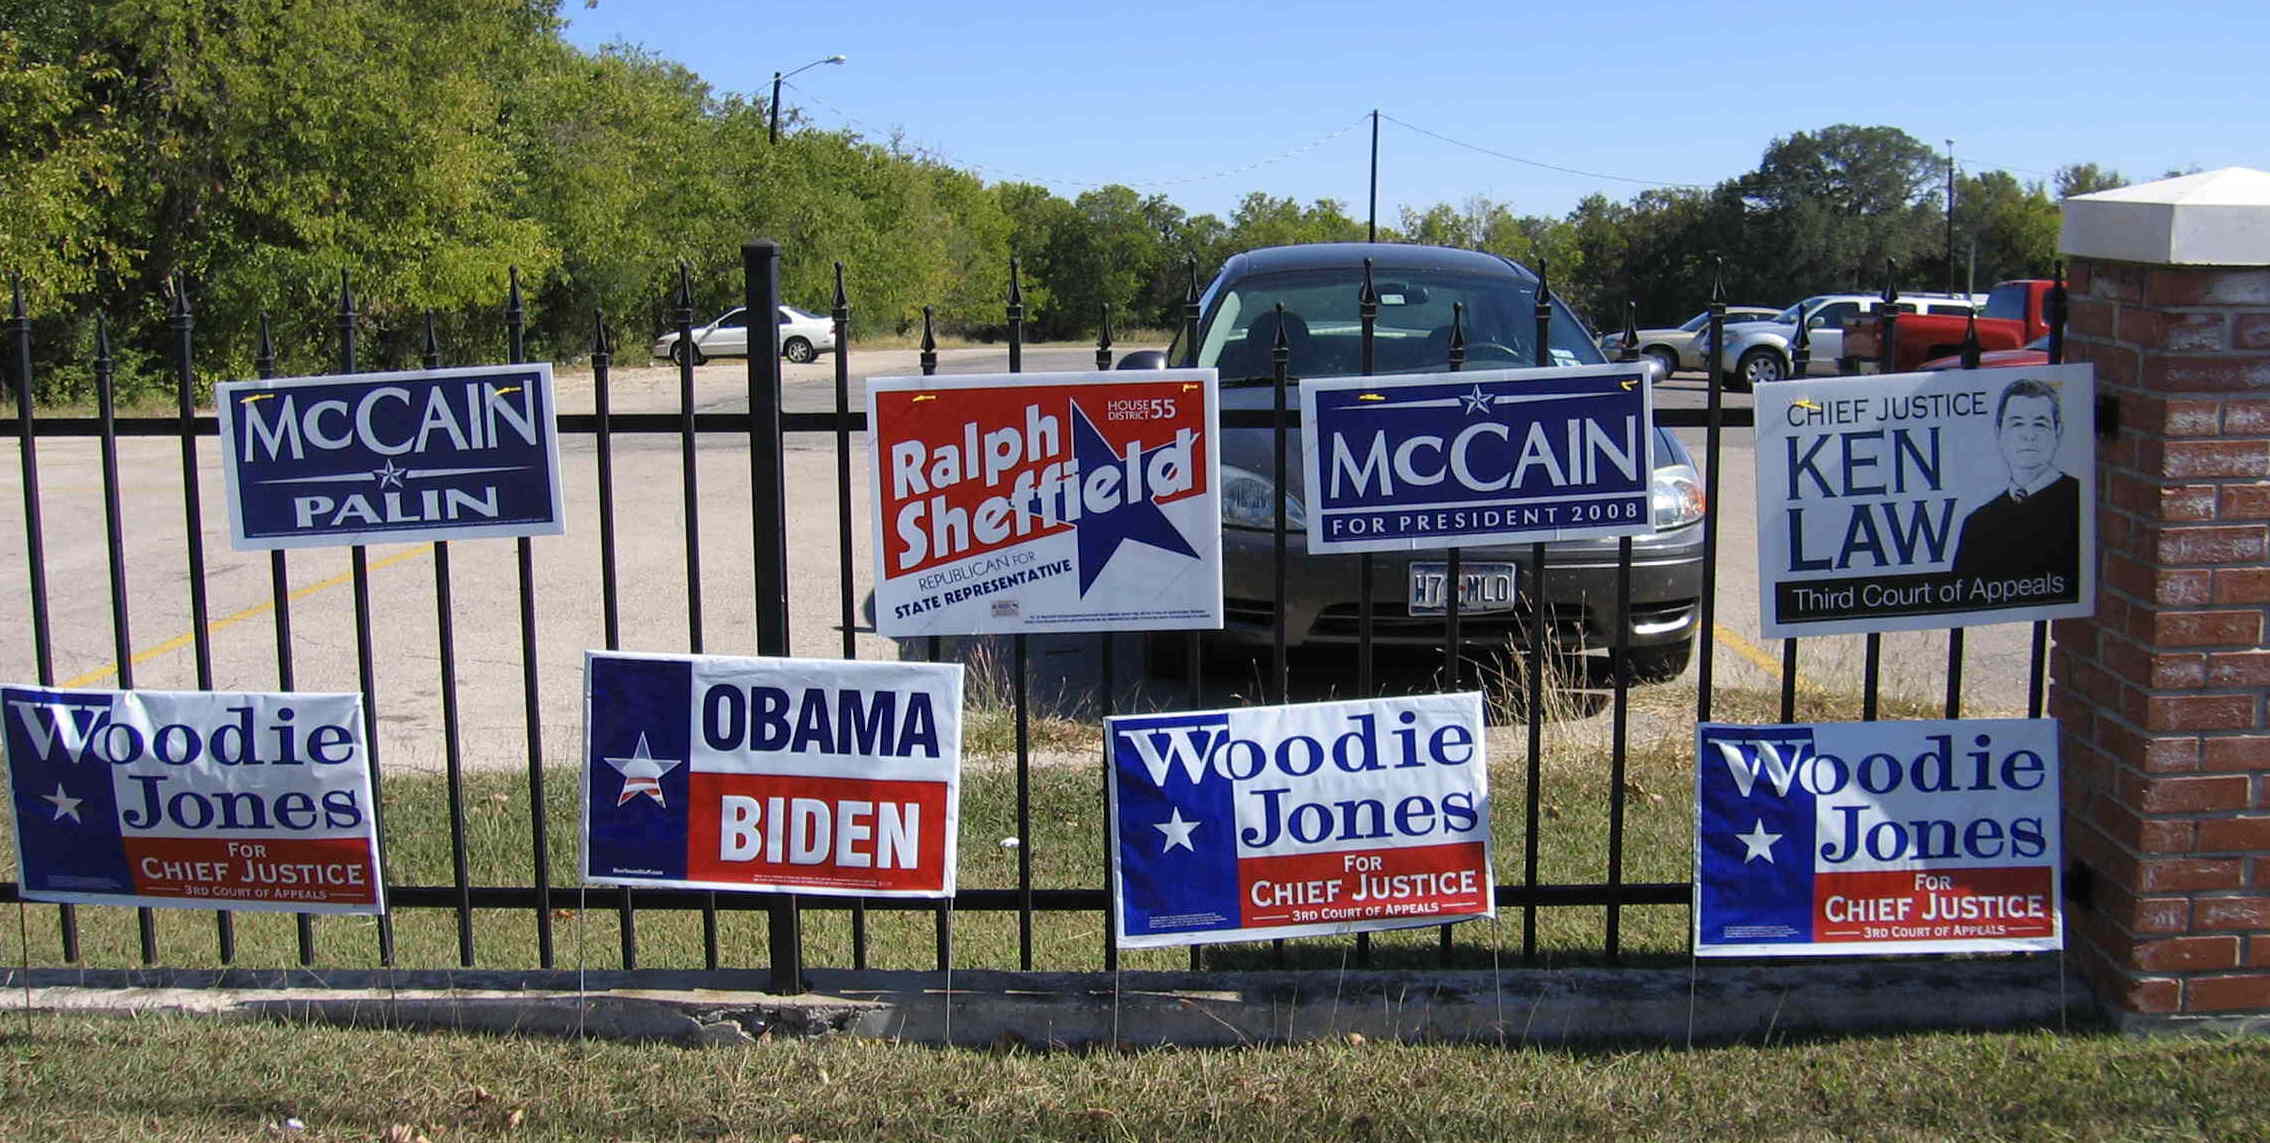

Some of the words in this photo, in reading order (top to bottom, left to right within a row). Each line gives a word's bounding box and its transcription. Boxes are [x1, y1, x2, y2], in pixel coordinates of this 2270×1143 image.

[1107, 399, 1149, 411] HOUSE
[1107, 411, 1149, 421] DISTRICT
[1150, 399, 1176, 419] 55
[1786, 398, 1869, 427] CHIEF
[1876, 392, 1988, 421] JUSTICE
[891, 404, 1059, 500] Ralph
[1785, 426, 1943, 501] KEN
[294, 486, 499, 528] PALIN
[896, 427, 1200, 570] Sheffield
[1332, 519, 1386, 536] FOR
[1400, 507, 1558, 532] PRESIDENT
[1571, 502, 1638, 522] 2008
[1786, 497, 1957, 573] LAW
[895, 595, 942, 619] STATE
[944, 559, 1073, 606] REPRESENTATIVE
[918, 554, 1009, 592] REPUBLICAN
[1012, 551, 1036, 565] FOR
[1793, 585, 1855, 611] Third
[1862, 581, 1932, 607] Court
[1937, 577, 1965, 602] of
[1969, 571, 2065, 602] Appeals
[8, 699, 355, 764] Woodie
[702, 683, 940, 758] OBAMA
[1119, 711, 1473, 787] Woodie
[1708, 735, 2046, 798] Woodie
[122, 774, 362, 830] Jones
[1241, 788, 1478, 848] Jones
[228, 842, 267, 858] FOR
[720, 794, 920, 869] BIDEN
[1820, 806, 2047, 864] Jones
[141, 857, 228, 882] CHIEF
[240, 860, 365, 885] JUSTICE
[1344, 855, 1382, 872] FOR
[1914, 874, 1951, 891] FOR
[212, 887, 252, 899] COURT
[256, 888, 270, 899] OF
[273, 889, 327, 900] APPEALS
[1251, 880, 1342, 907] CHIEF
[1352, 869, 1477, 901] JUSTICE
[1825, 896, 1912, 922] CHIEF
[1922, 892, 2045, 920] JUSTICE
[1321, 906, 1362, 920] COURT
[1366, 906, 1382, 917] OF
[1385, 902, 1439, 916] APPEALS
[1891, 926, 1931, 938] COURT
[1934, 926, 1949, 937] OF
[1953, 924, 2006, 936] APPEALS
